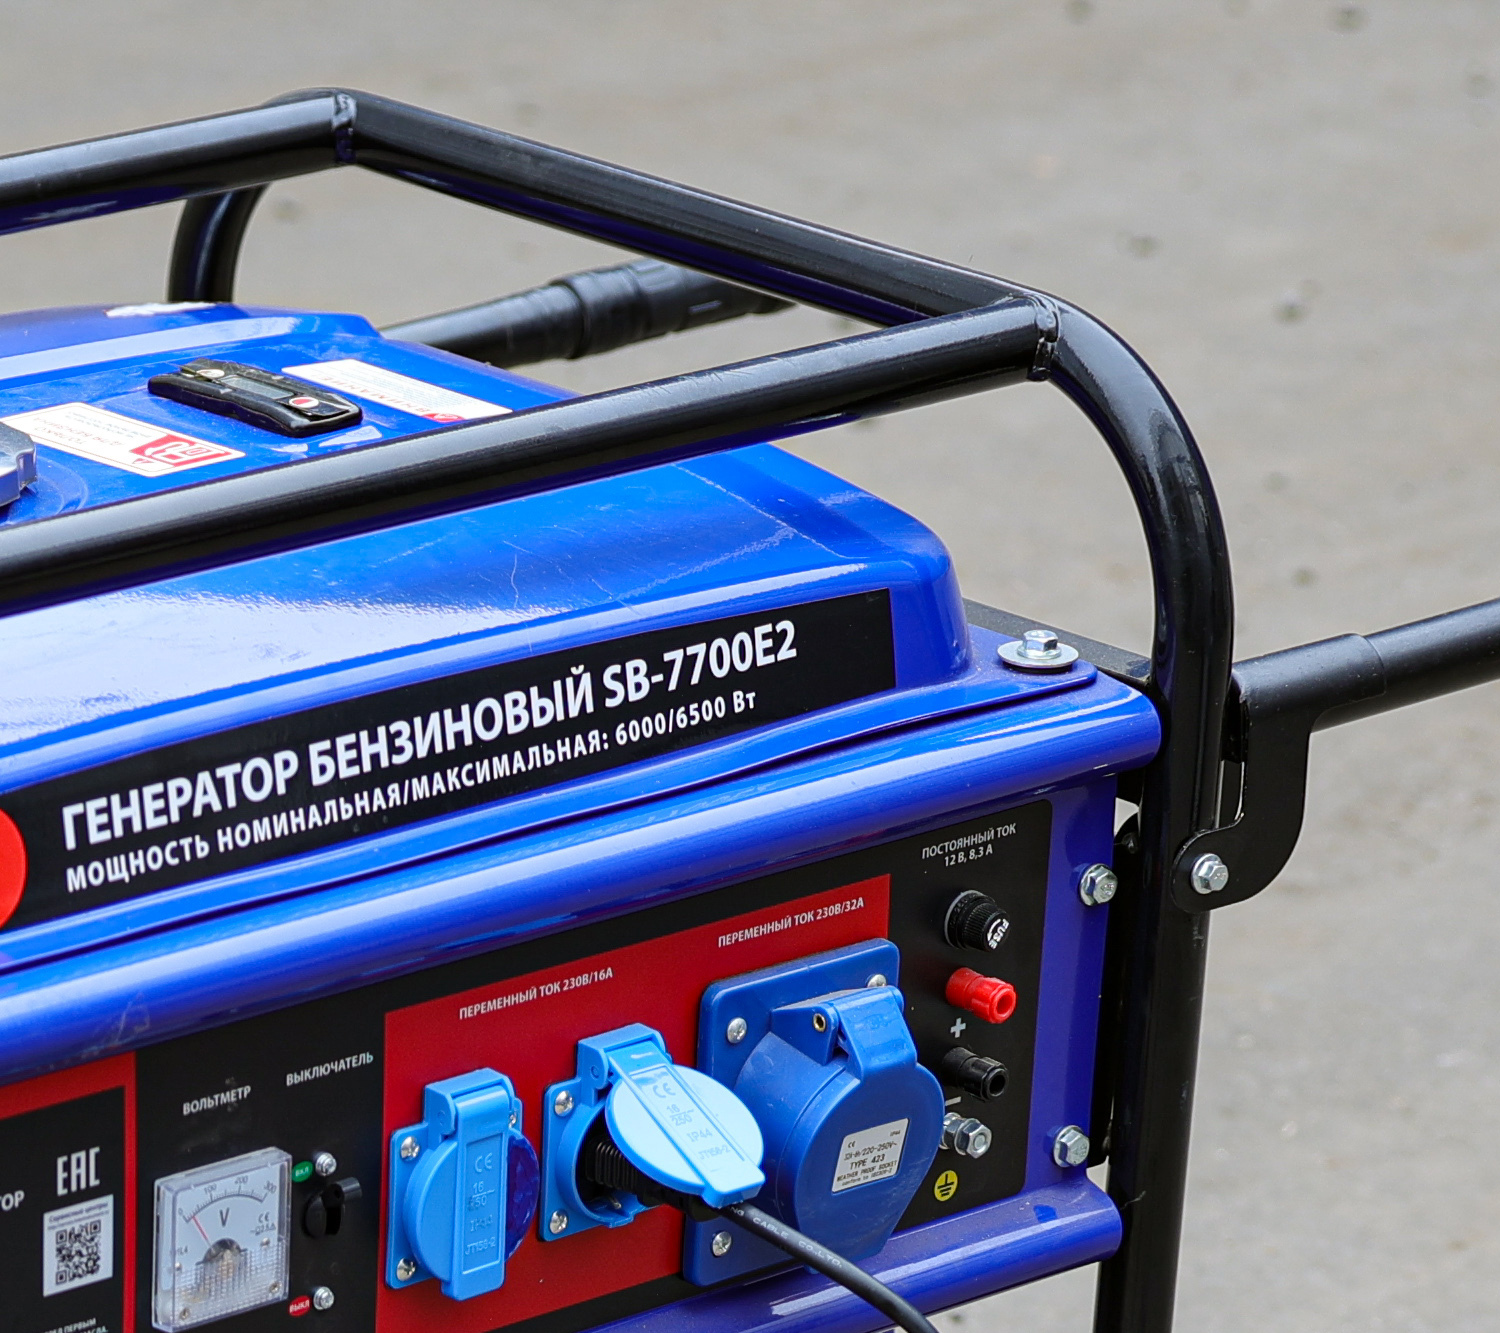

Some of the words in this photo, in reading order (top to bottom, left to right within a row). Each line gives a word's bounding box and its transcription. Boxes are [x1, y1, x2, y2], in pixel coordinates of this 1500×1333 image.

[63, 750, 298, 850] ГЕНЕРАТОР
[309, 665, 594, 786] БЕНЗИНОВЫЙ
[603, 620, 797, 708] SB-7700E2
[67, 835, 209, 893] МОЩНОСТЬ
[217, 729, 609, 852] НОМИНАЛЬНАЯ/МАКСИМАЛЬНАЯ:
[616, 695, 726, 746] 6000/6500
[733, 691, 756, 714] Вт
[922, 827, 995, 860] ПОСТОЯННЫЙ
[997, 823, 1017, 837] ТОК
[945, 855, 956, 867] 12
[969, 846, 984, 860] 8,3
[718, 916, 792, 948] ПЕРЕМЕННЫЙ
[794, 910, 815, 926] ТОК
[816, 896, 864, 920] 230В/32А
[988, 918, 1010, 950] FUSE
[459, 987, 537, 1020] ПЕРЕМЕННЫЙ
[539, 981, 561, 998] ТОК
[563, 967, 613, 992] 230В/16А
[286, 1051, 373, 1087] ВЫКЛЮЧАТЕЛЬ
[183, 1086, 251, 1116] ВОЛЬТМЕТР
[653, 1082, 676, 1098] CE
[686, 1128, 713, 1142] IP44
[475, 1153, 493, 1173] CE
[850, 1158, 868, 1170] TYPE
[220, 1208, 230, 1228] V
[753, 1217, 789, 1239] CABLE
[289, 1299, 310, 1313] ВЫКЛ
